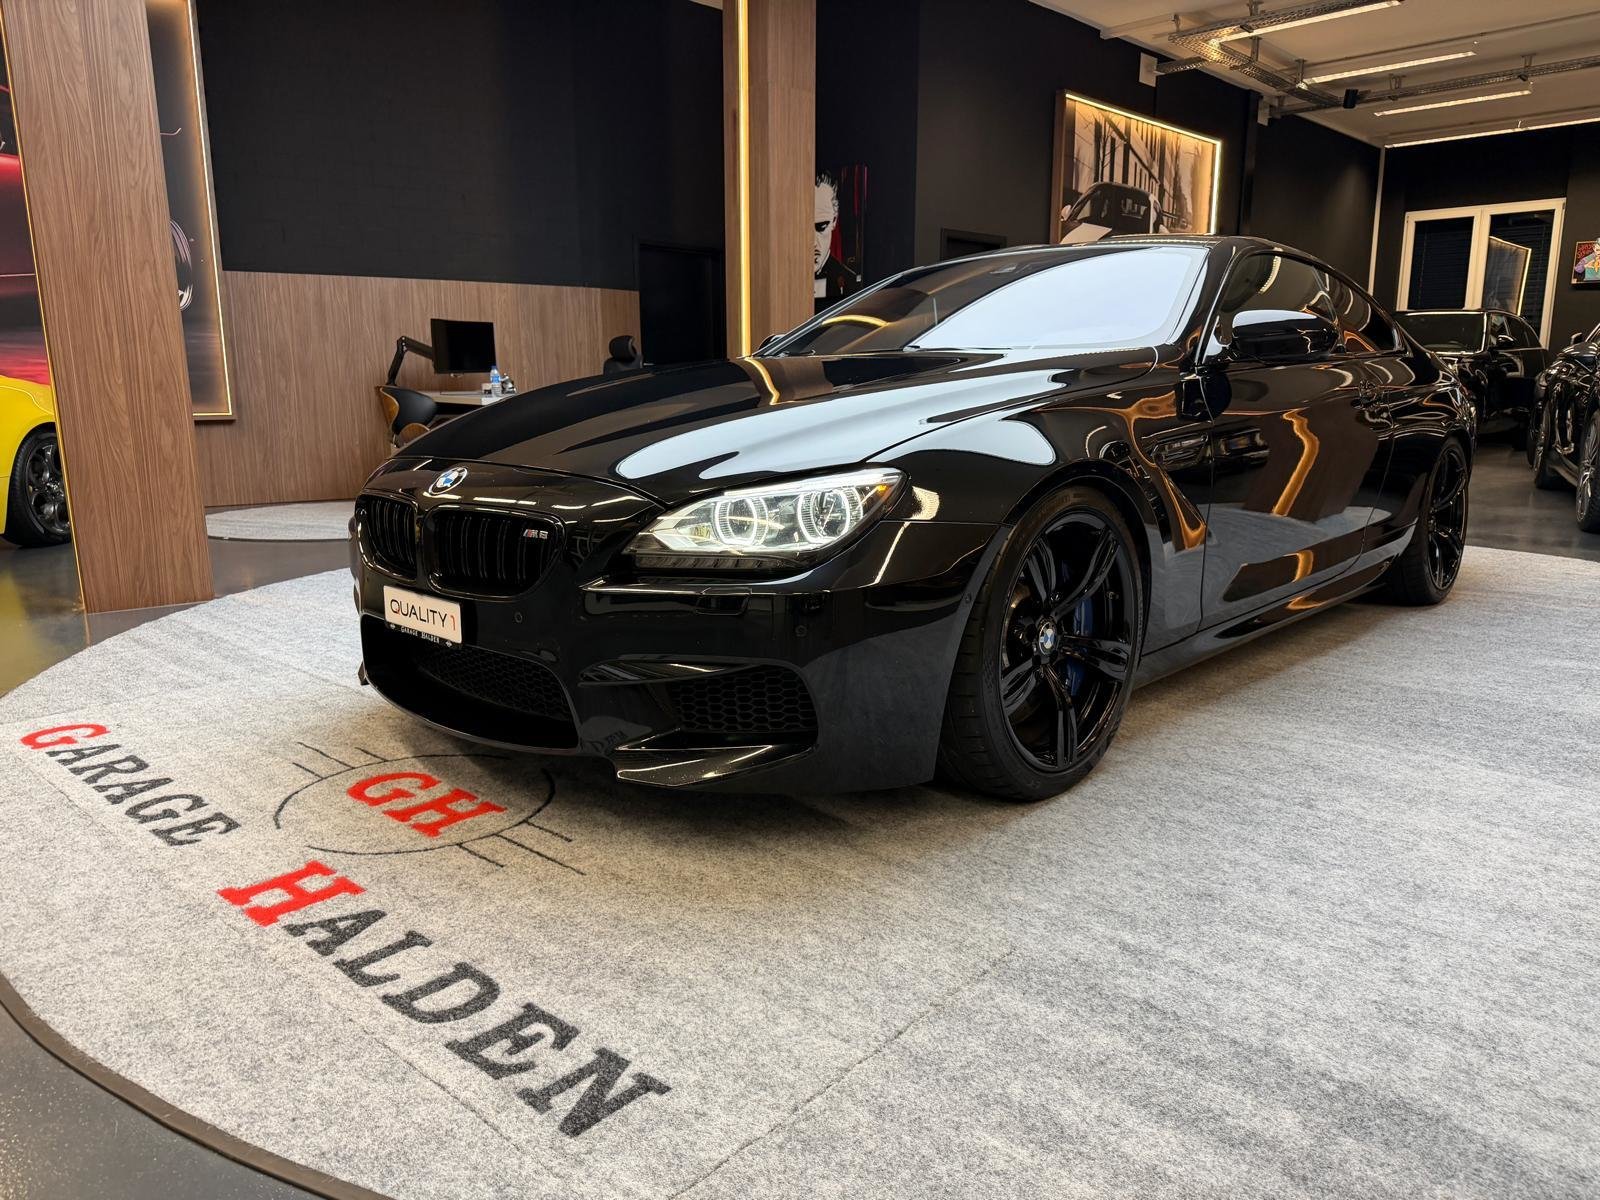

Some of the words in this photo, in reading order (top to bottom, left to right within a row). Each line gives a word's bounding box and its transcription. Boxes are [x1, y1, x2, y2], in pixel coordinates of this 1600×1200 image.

[347, 771, 505, 838] GH
[21, 723, 241, 848] GARAGE
[218, 860, 670, 1138] HALDEN
